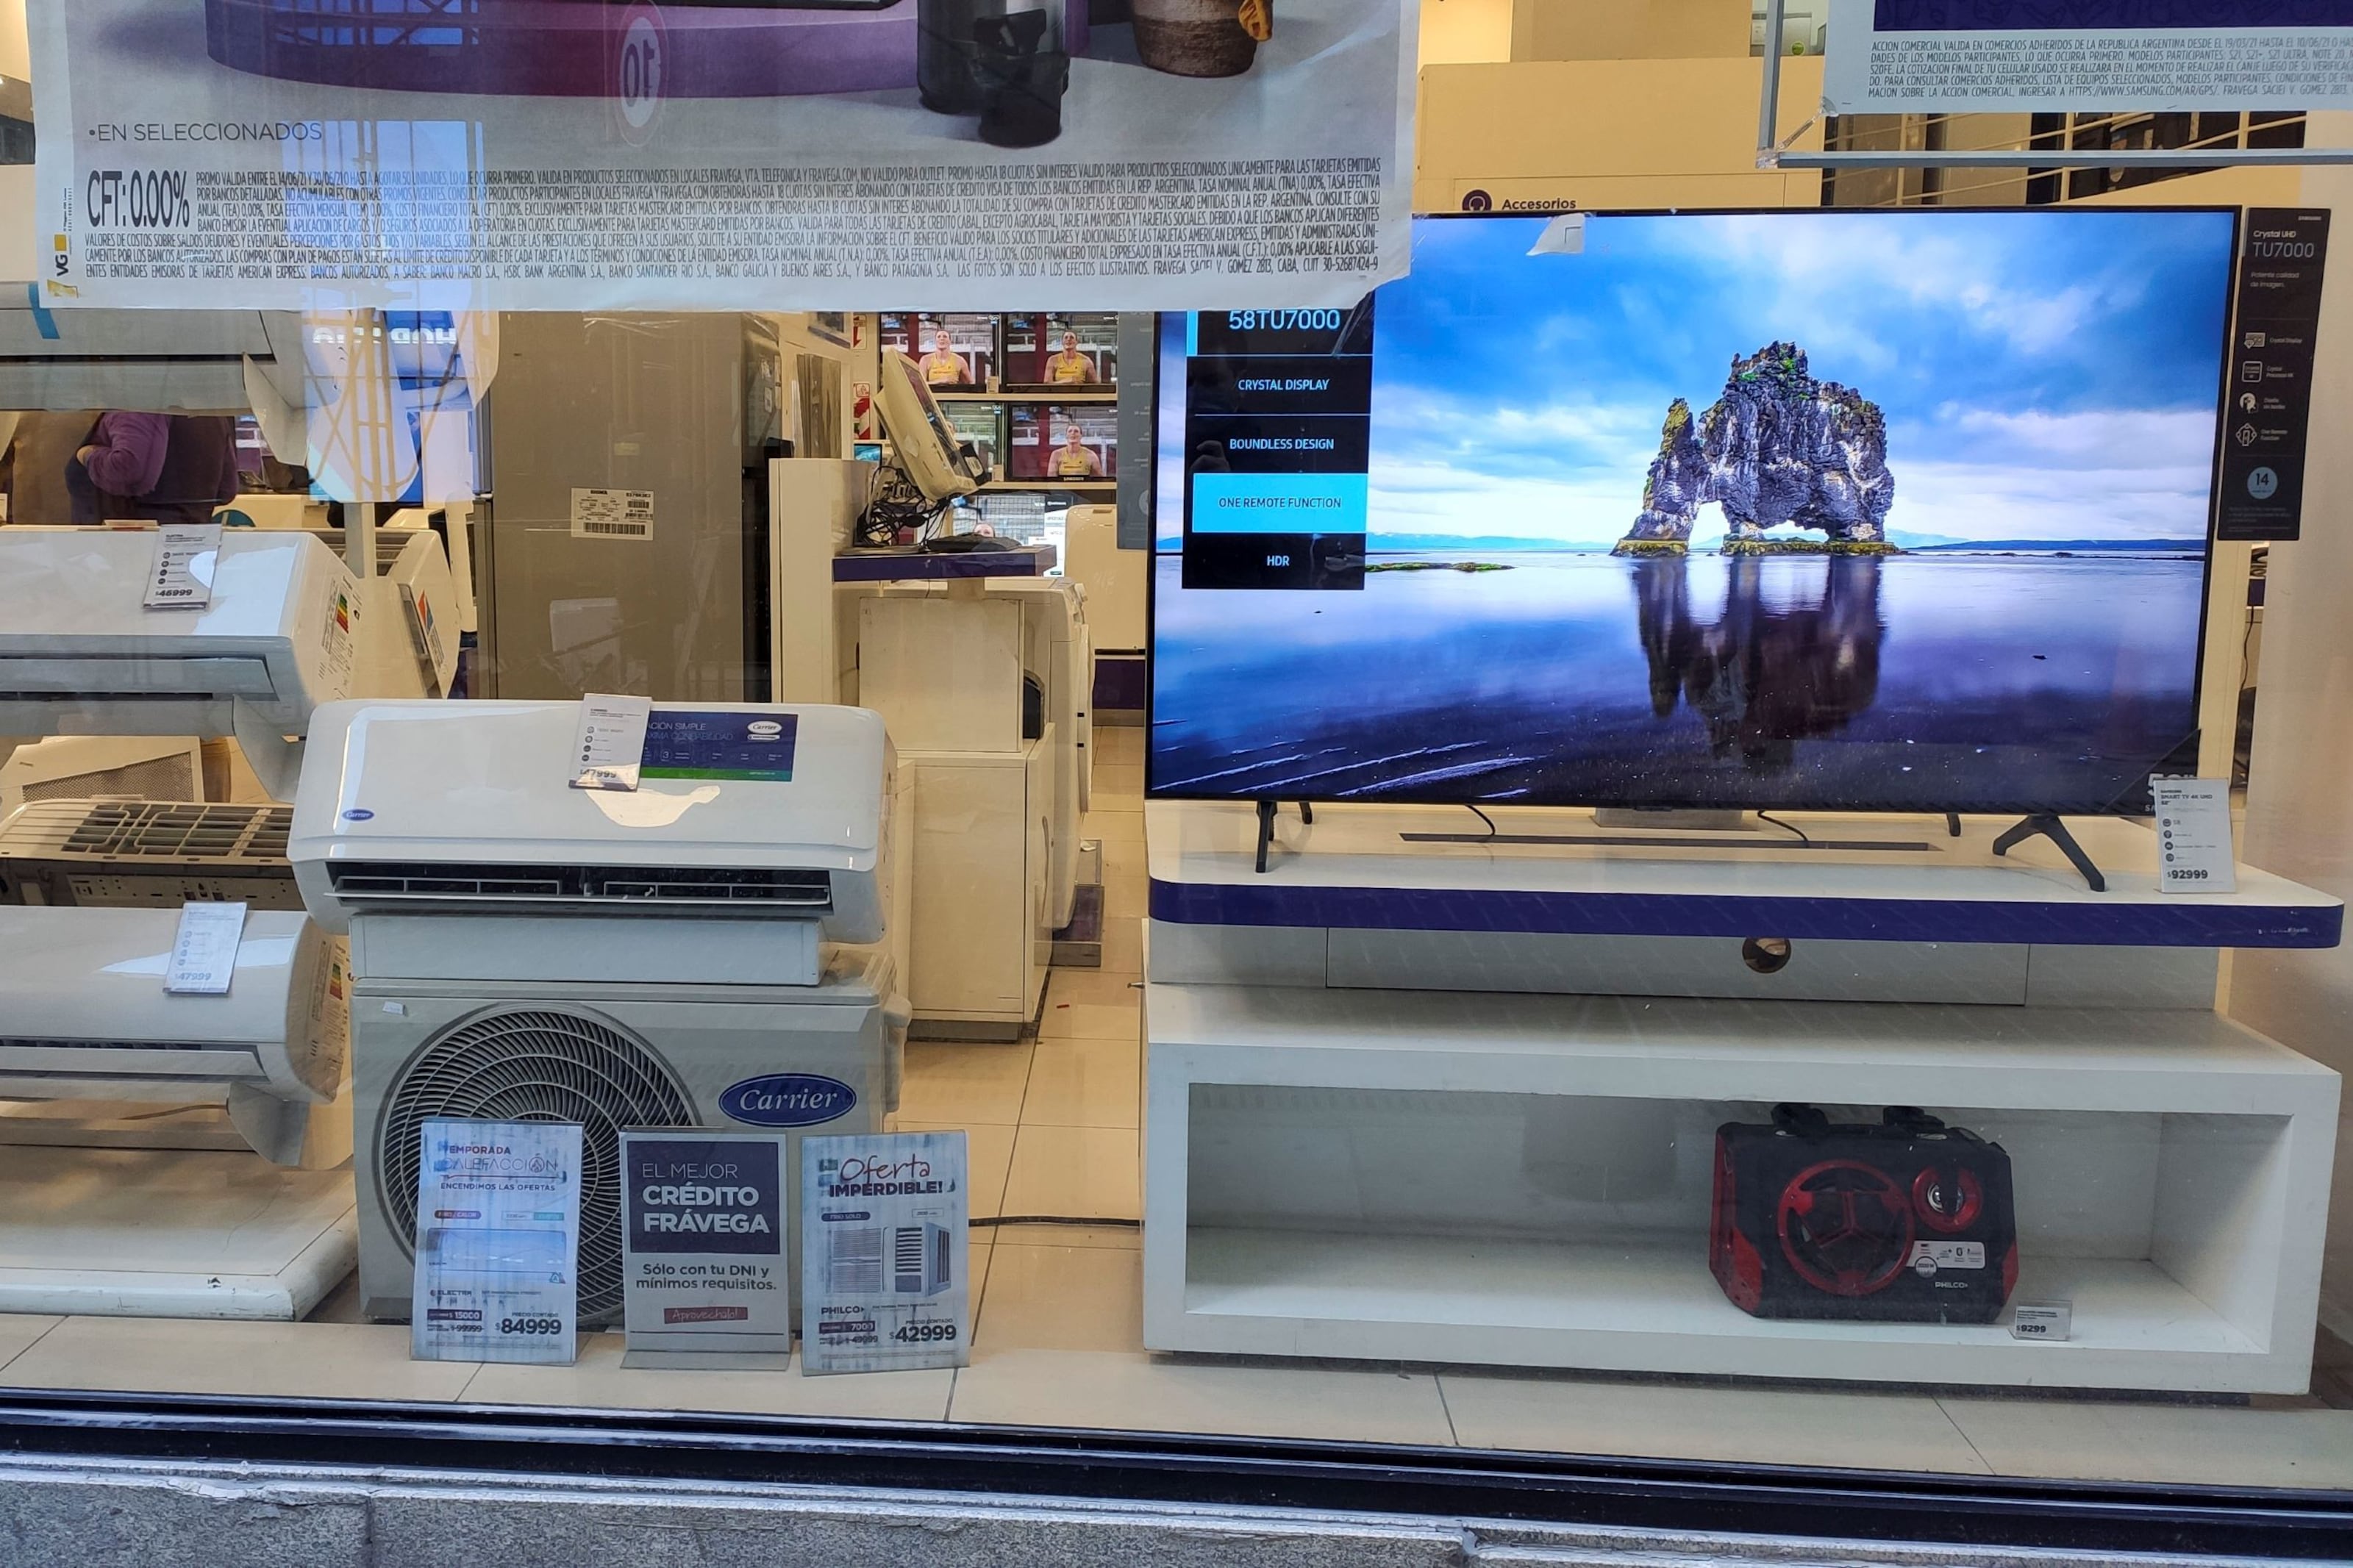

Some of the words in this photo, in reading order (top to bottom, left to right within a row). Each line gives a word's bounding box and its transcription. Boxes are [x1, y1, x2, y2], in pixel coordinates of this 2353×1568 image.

[134, 123, 322, 140] SELECCIONADOS
[88, 170, 126, 228] CFT:
[130, 170, 190, 228] 0.00%
[1502, 198, 1577, 210] Accesorios
[2253, 230, 2280, 239] Crystal
[2252, 242, 2315, 257] TU7000
[55, 254, 69, 276] VG
[1228, 309, 1340, 330] 58TU7000
[1238, 379, 1283, 390] CRYSTAL
[1285, 379, 1329, 390] DISPLAY
[1229, 439, 1293, 450] BOUNDLESS
[1295, 439, 1335, 450] DESIGN
[2256, 473, 2269, 486] 14
[1218, 498, 1241, 508] ONE
[1243, 498, 1285, 508] REMOTE
[1288, 498, 1342, 508] FUNCTION
[1267, 556, 1290, 566] HDR
[740, 1088, 838, 1111] Carrier
[643, 1164, 665, 1178] EL
[671, 1164, 738, 1179] MEJOR
[840, 1153, 930, 1185] Oferta
[440, 1183, 496, 1191] ENCENDIMOS
[499, 1183, 515, 1191] LAS
[643, 1181, 760, 1206] CRÉDITO
[829, 1181, 943, 1198] IMPERDIBLE!
[643, 1209, 771, 1234] FRÁVEGA
[643, 1263, 675, 1275] Sólo
[680, 1267, 706, 1275] con
[710, 1264, 725, 1275] tu
[730, 1265, 756, 1276] DNI
[761, 1267, 770, 1278] y
[636, 1278, 698, 1289] mínimos
[702, 1279, 777, 1291] requisitos.
[821, 1306, 860, 1314] PHILCO
